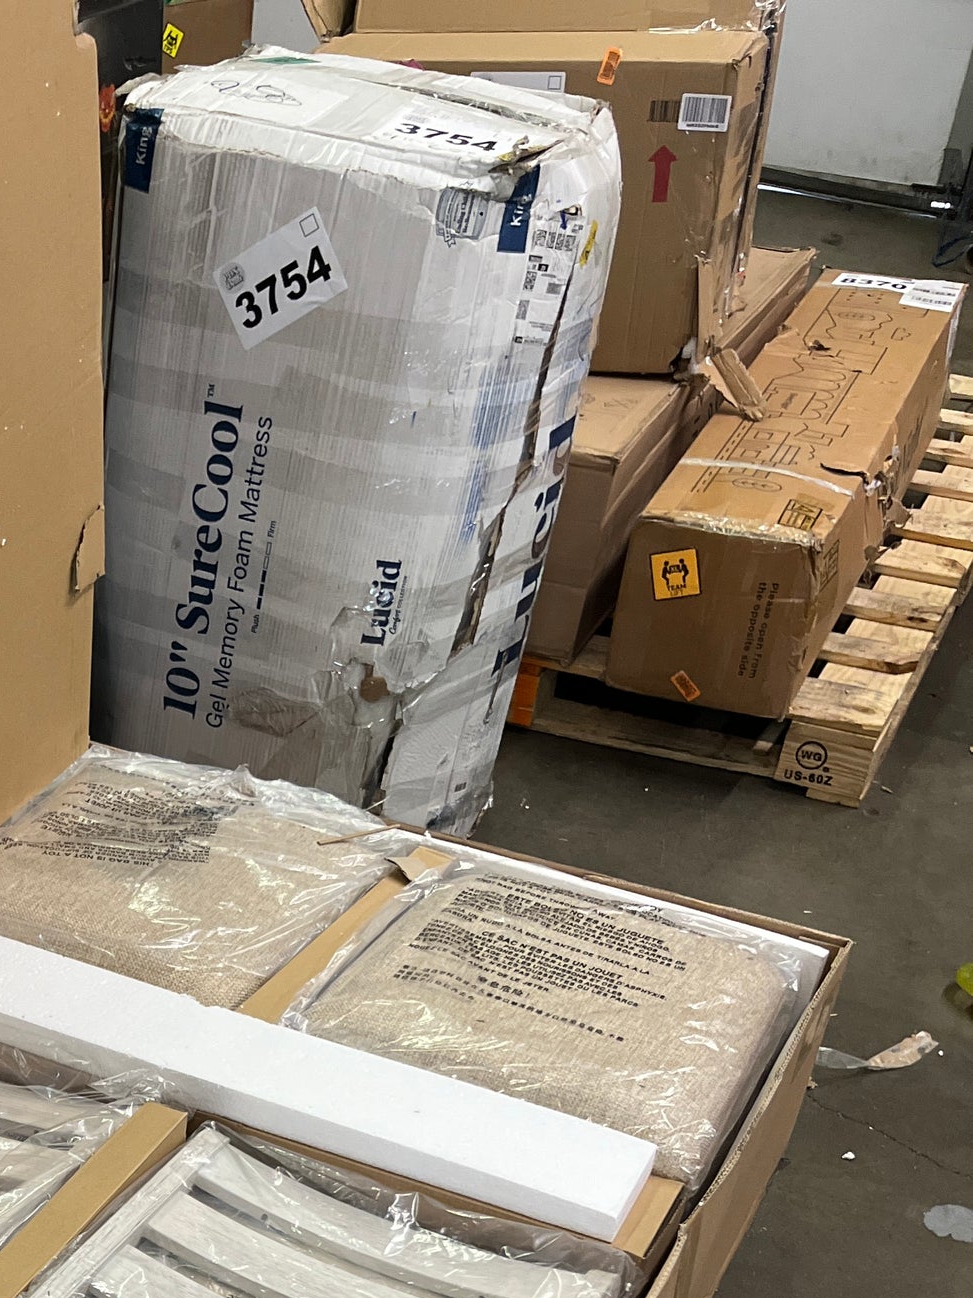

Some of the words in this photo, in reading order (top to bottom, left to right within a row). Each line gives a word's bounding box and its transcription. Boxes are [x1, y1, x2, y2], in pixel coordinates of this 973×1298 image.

[135, 126, 153, 165] King
[394, 123, 498, 153] 3754
[510, 194, 533, 227] King
[235, 245, 333, 330] 3754
[840, 278, 907, 290] 8370
[238, 416, 273, 524] Mattress
[227, 530, 254, 593] Foam
[251, 614, 260, 634] Plush
[267, 520, 276, 538] Firm
[360, 559, 403, 647] Lucid
[756, 582, 767, 600] the
[211, 598, 245, 689] Memory
[743, 604, 760, 652] opposite
[756, 622, 767, 650] open
[738, 655, 747, 677] side
[748, 653, 762, 679] from
[206, 693, 227, 729] Gel
[801, 750, 822, 762] WG
[784, 769, 833, 786] US-60Z
[496, 934, 519, 945] SAC
[549, 952, 571, 963] PAS
[571, 960, 587, 968] UN
[587, 965, 623, 980] JOUET
